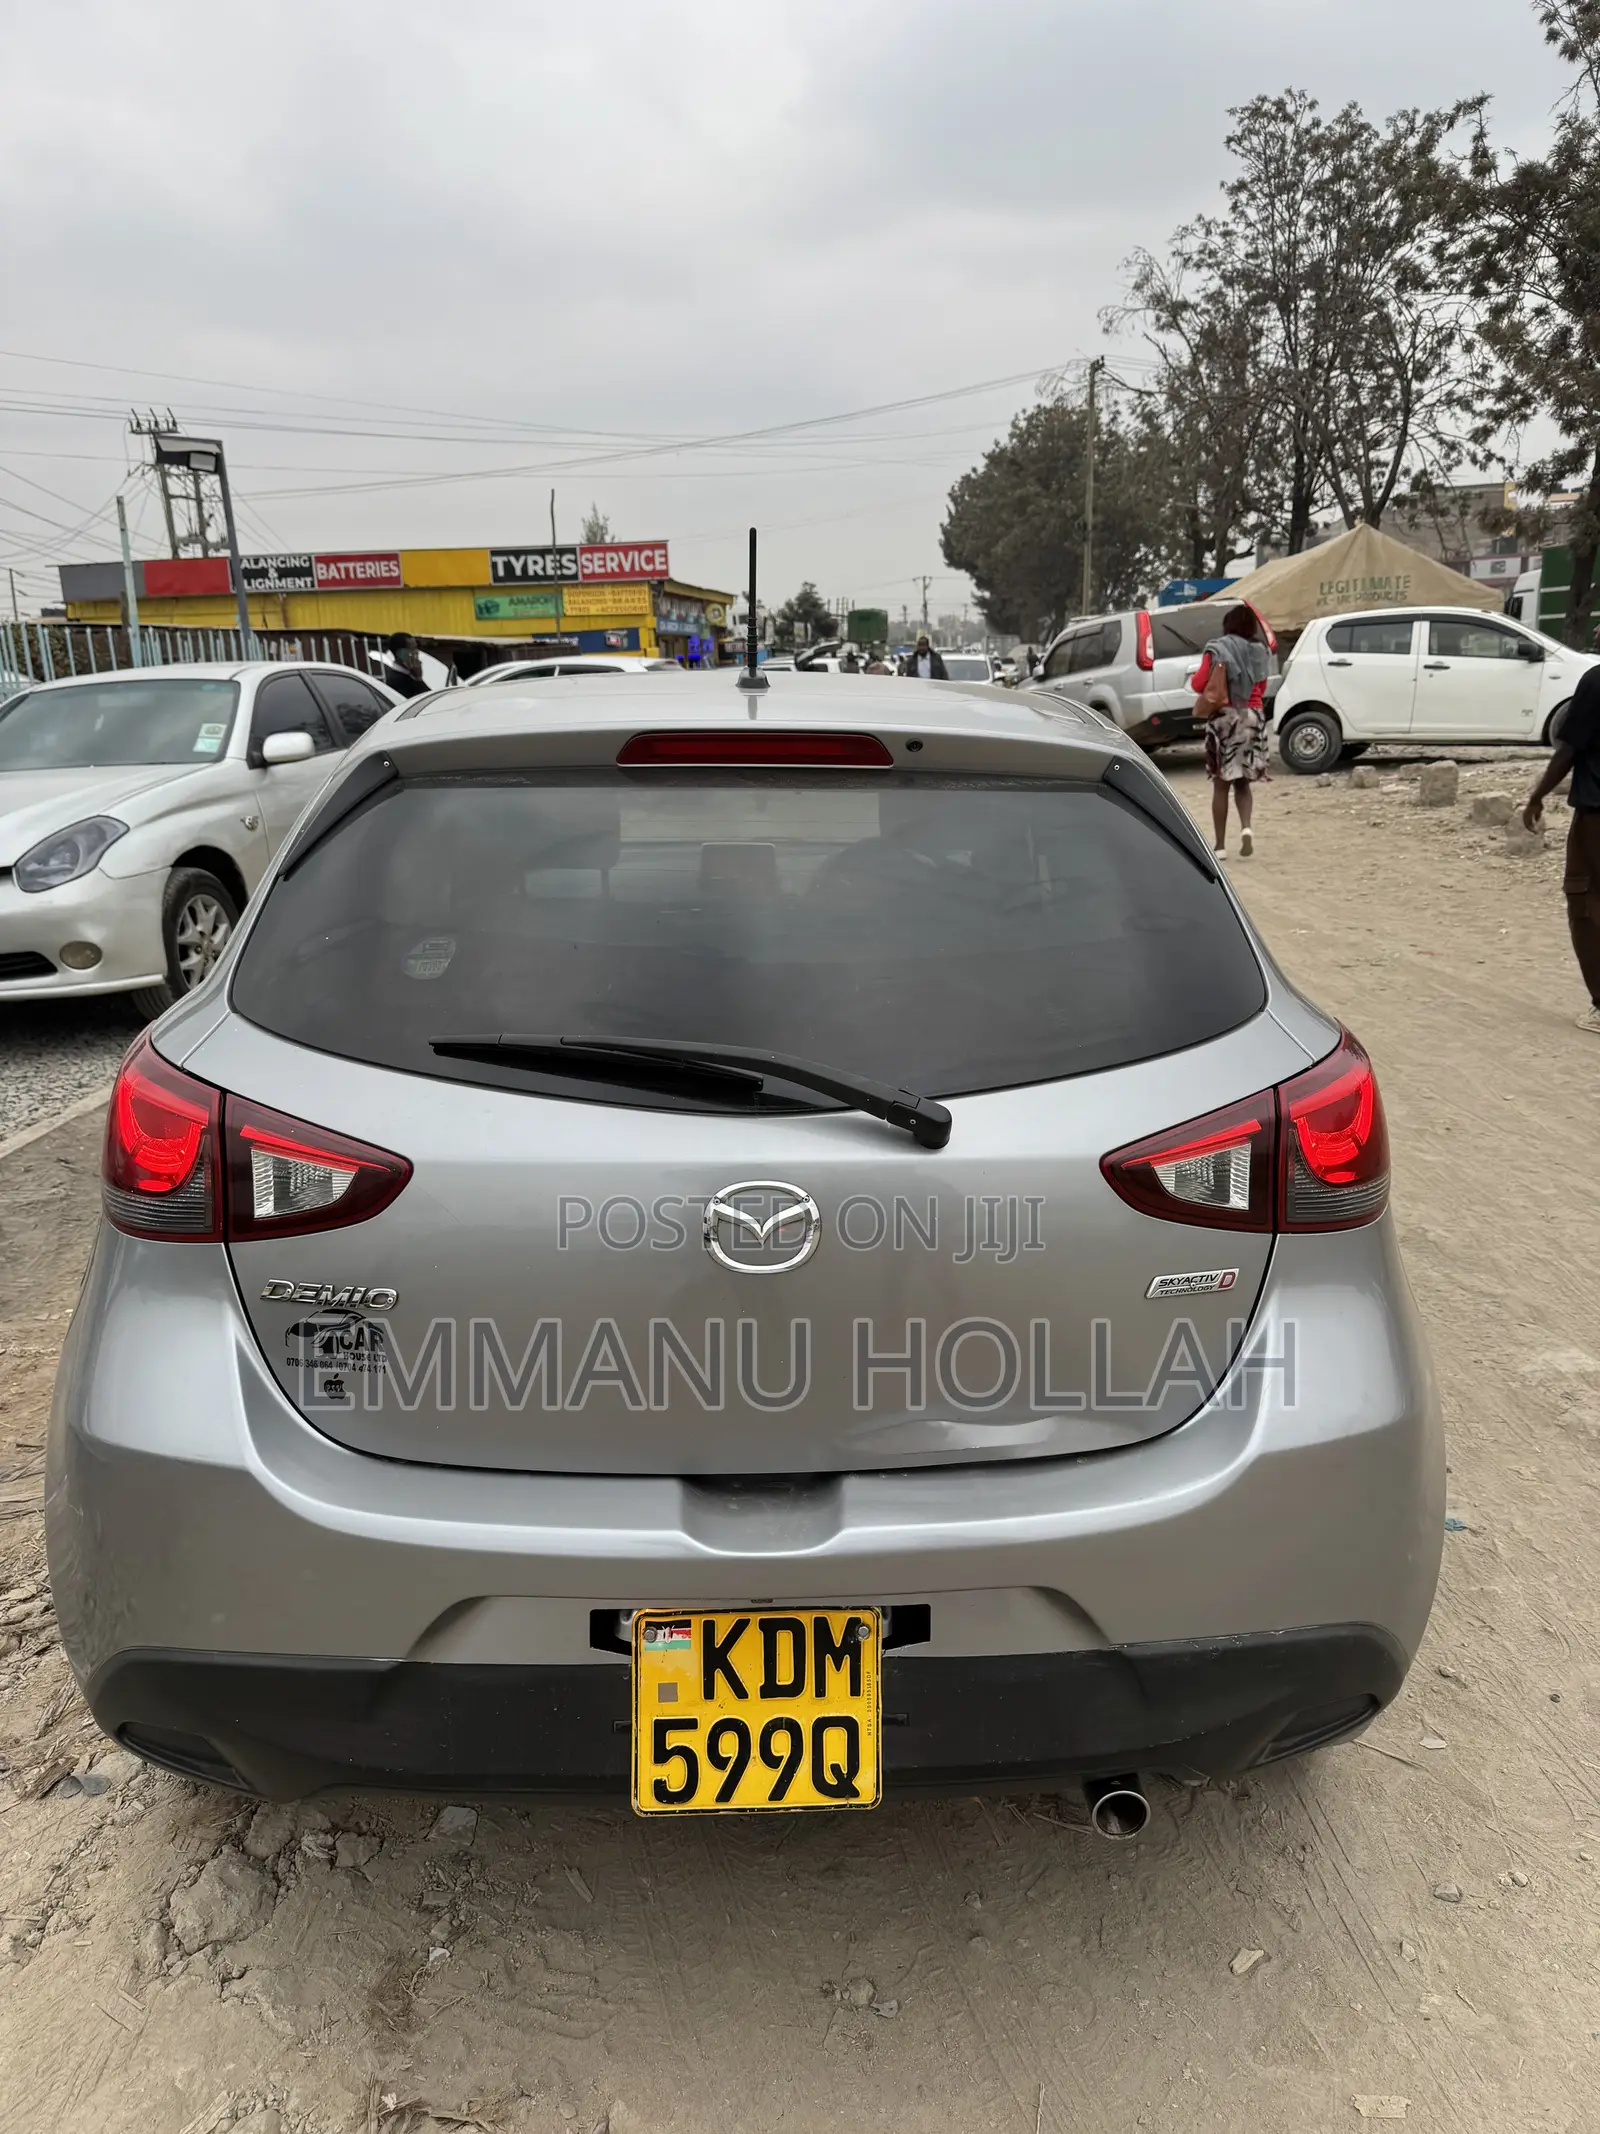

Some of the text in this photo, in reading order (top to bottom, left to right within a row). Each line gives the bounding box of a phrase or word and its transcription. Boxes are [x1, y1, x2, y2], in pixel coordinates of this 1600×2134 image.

[240, 556, 310, 569] ALANCING
[316, 561, 400, 580] BATTERIES
[492, 554, 578, 577] TYRES
[581, 549, 668, 574] SERVICE
[267, 568, 278, 578] &
[243, 577, 313, 590] LIGNMENT
[1320, 574, 1411, 596] LEGITIMATE
[1159, 1273, 1219, 1287] SKYACTIV
[1159, 1284, 1216, 1296] TECHNOLOGY
[260, 1278, 399, 1310] DEMIO
[340, 1327, 383, 1352] CAR
[343, 1352, 371, 1362] HOUSE
[702, 1616, 863, 1700] KDM
[653, 1715, 862, 1804] 599Q
